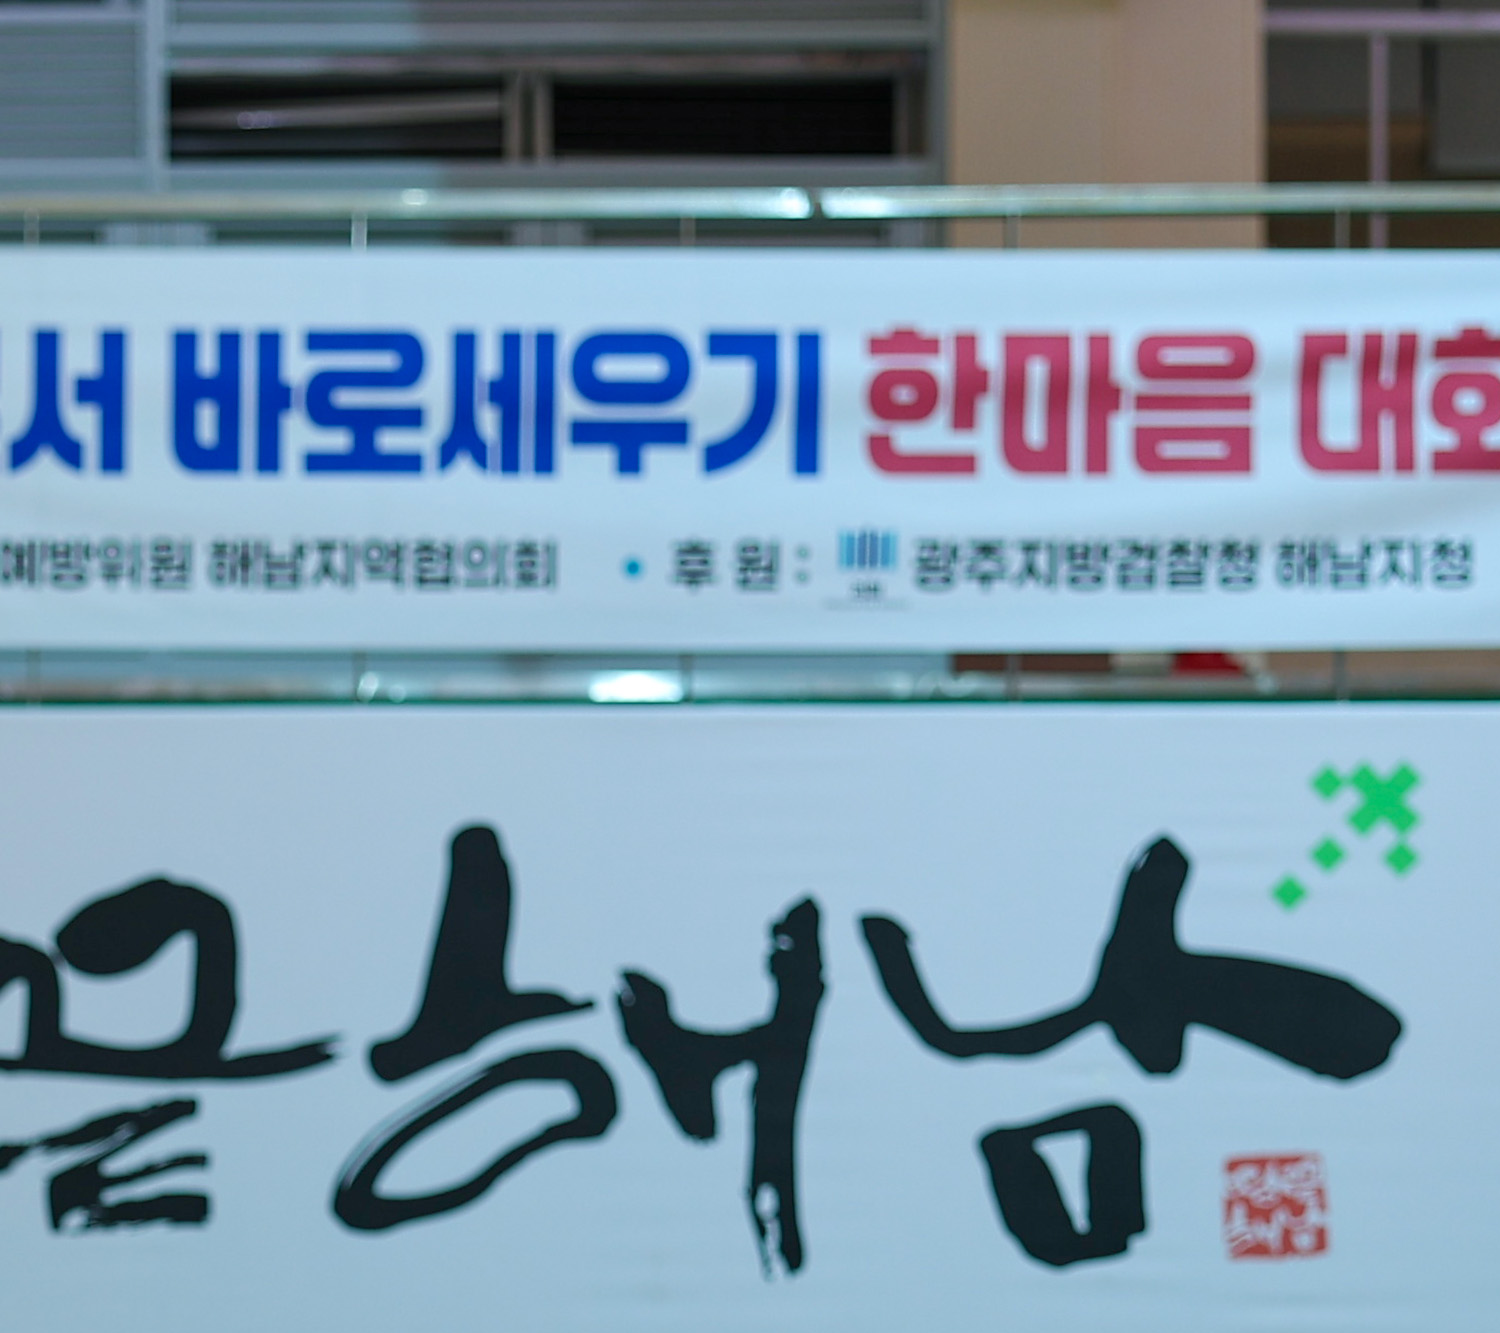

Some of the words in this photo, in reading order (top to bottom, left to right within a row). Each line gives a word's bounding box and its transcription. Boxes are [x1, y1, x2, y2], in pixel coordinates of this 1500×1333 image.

[170, 325, 822, 477] 바로세우기
[864, 326, 1259, 476] 한마음
[207, 538, 559, 592] 해남지역협의회
[913, 537, 1260, 592] 광주지방검찰청
[1274, 537, 1474, 593] 해남지청
